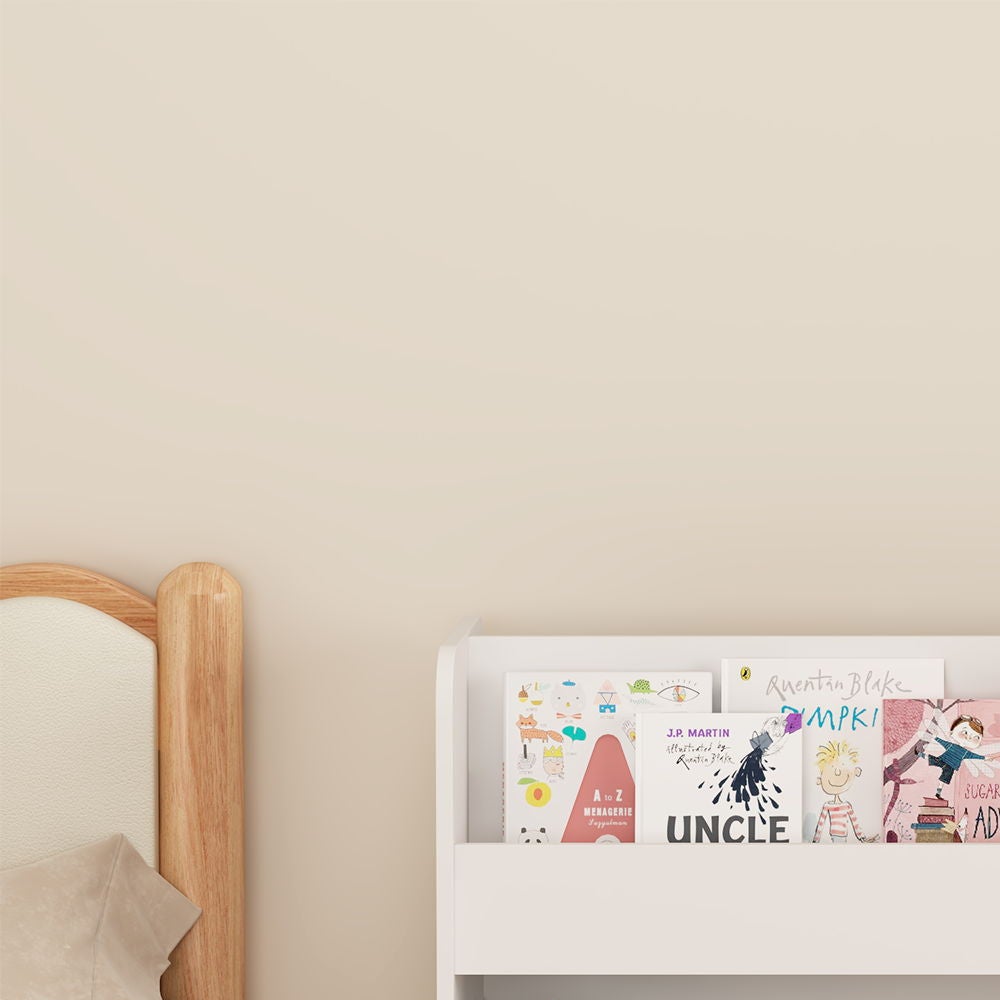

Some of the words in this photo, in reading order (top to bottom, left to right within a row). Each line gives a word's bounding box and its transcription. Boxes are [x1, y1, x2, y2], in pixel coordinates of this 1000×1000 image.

[765, 669, 844, 702] Quentin
[841, 670, 912, 701] Blake
[781, 705, 879, 731] MPKI
[666, 729, 684, 738] J.P.
[688, 728, 730, 738] MARTIN
[593, 789, 601, 802] A
[615, 789, 623, 802] Z
[584, 807, 633, 817] MENAGERIE
[666, 815, 790, 843] UNCLE
